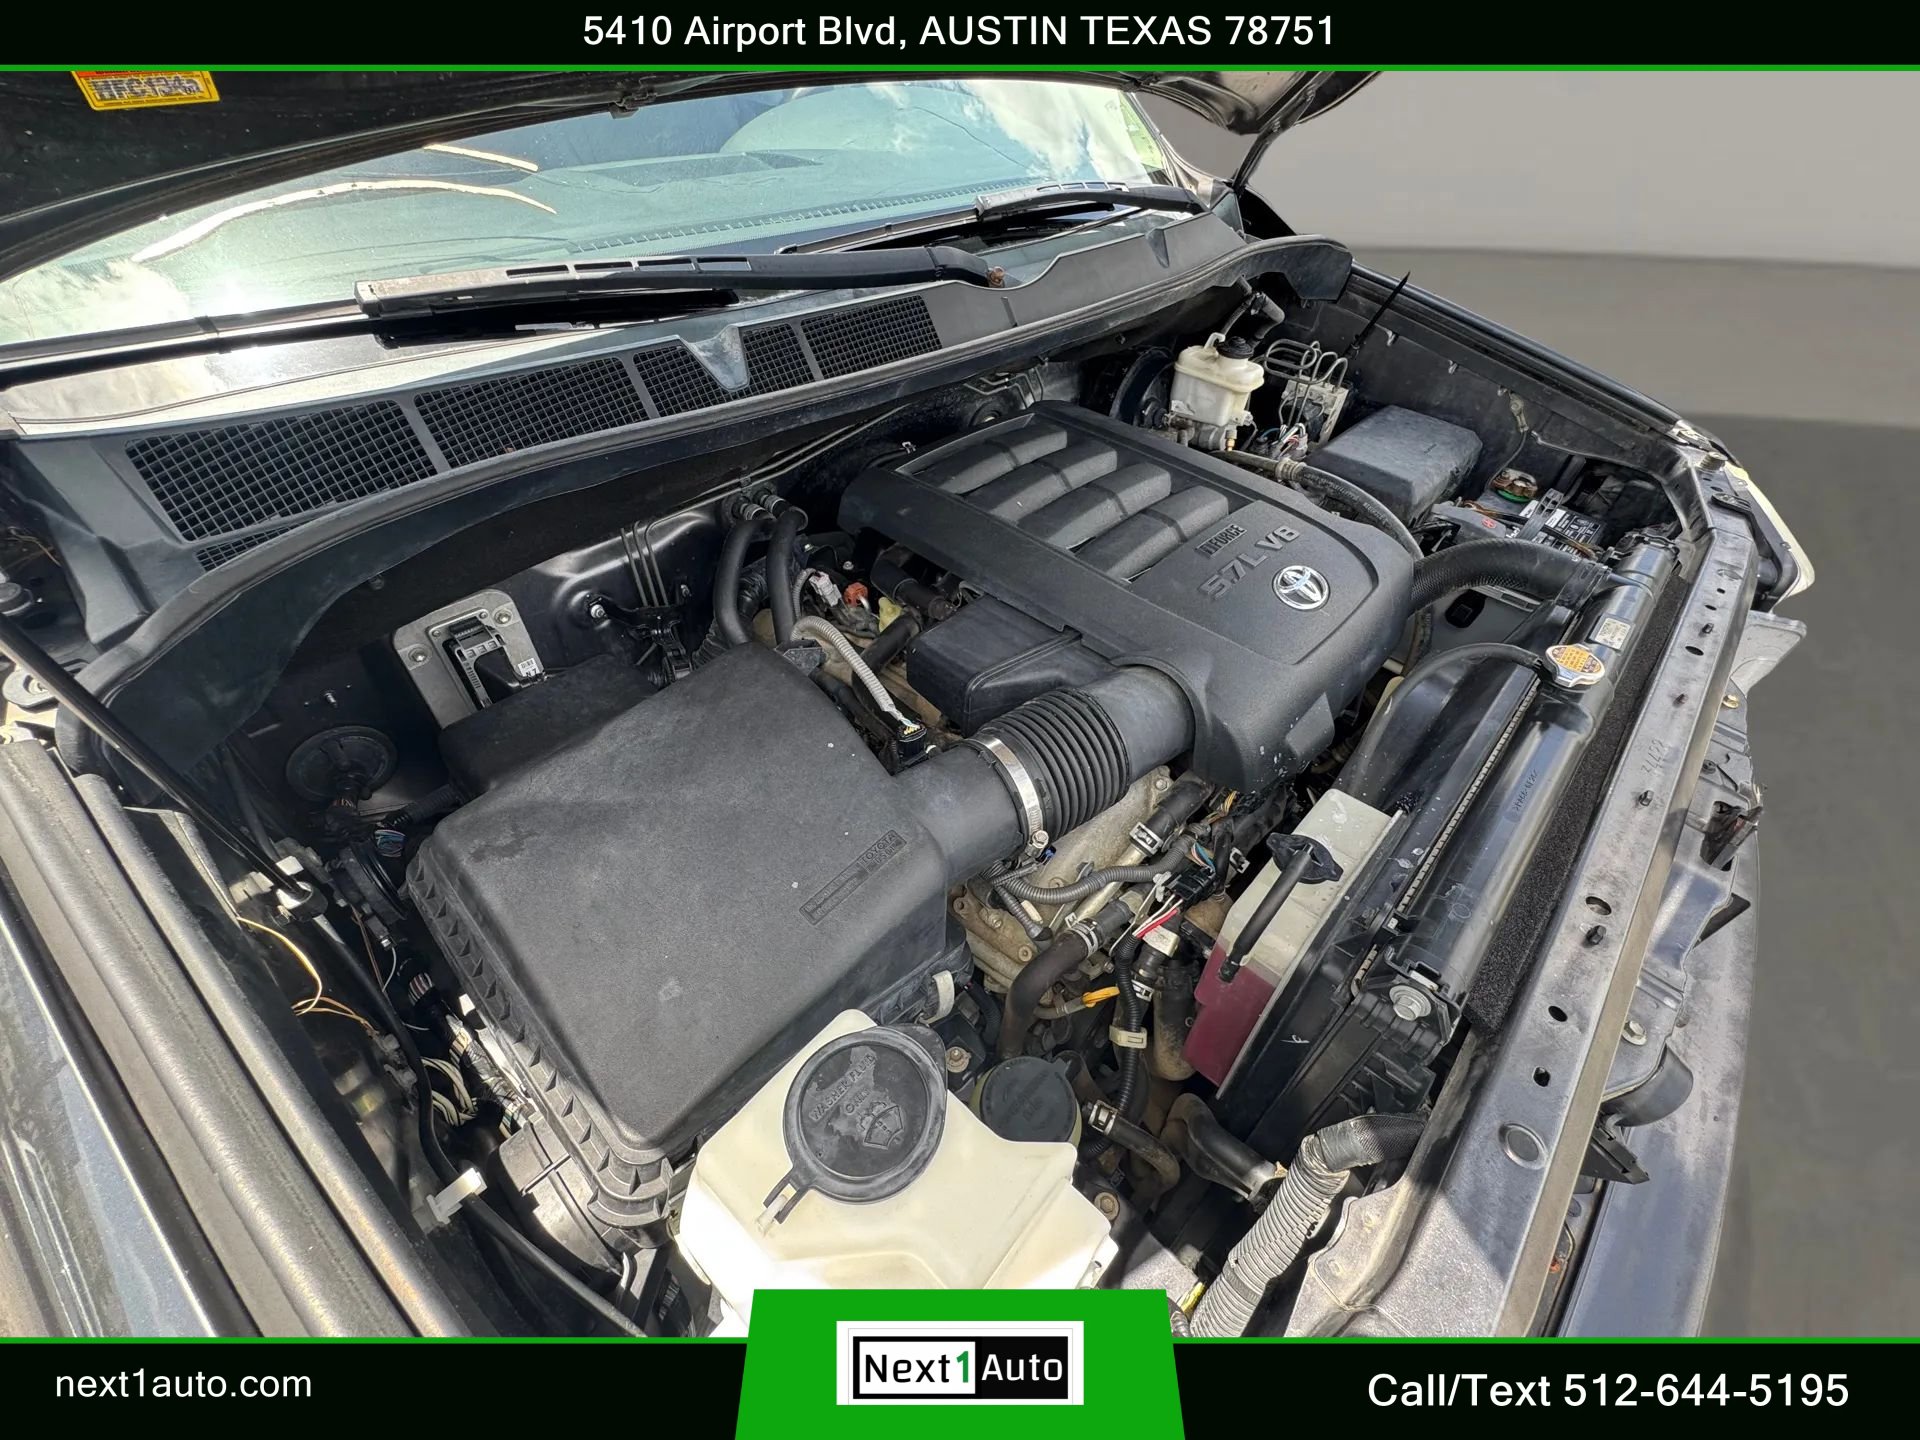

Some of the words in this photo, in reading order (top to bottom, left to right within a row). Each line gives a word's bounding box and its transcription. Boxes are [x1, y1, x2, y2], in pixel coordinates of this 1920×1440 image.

[1256, 525, 1300, 550] V8
[860, 834, 897, 864] TOYOTA
[811, 1078, 850, 1121] WASHER
[848, 1053, 877, 1083] FLUID
